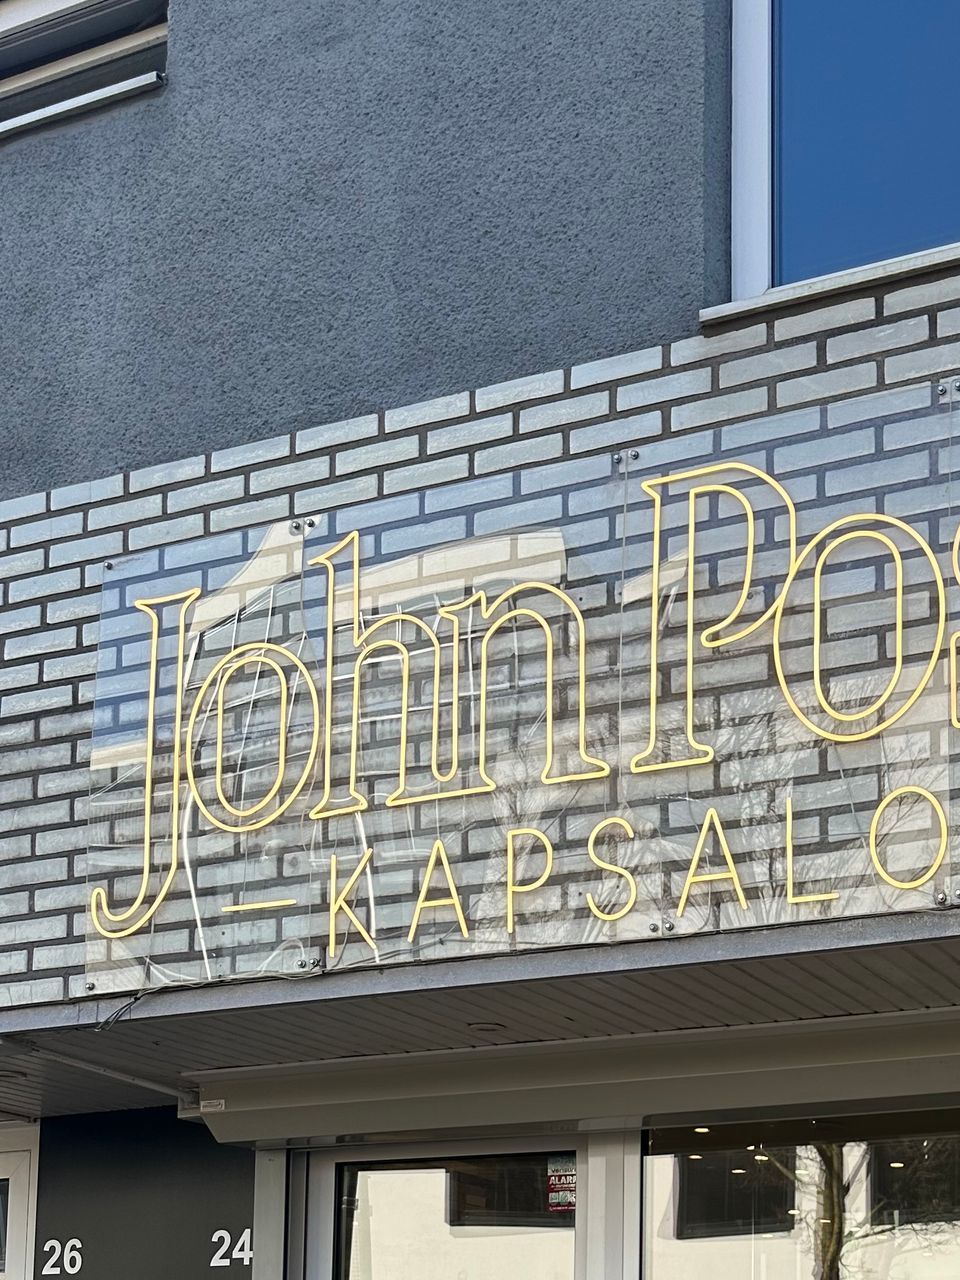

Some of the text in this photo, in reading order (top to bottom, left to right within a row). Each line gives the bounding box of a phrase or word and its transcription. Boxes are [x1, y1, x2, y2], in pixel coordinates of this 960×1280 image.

[90, 530, 611, 938] John
[41, 1238, 84, 1275] 26
[209, 1228, 254, 1267] 24
